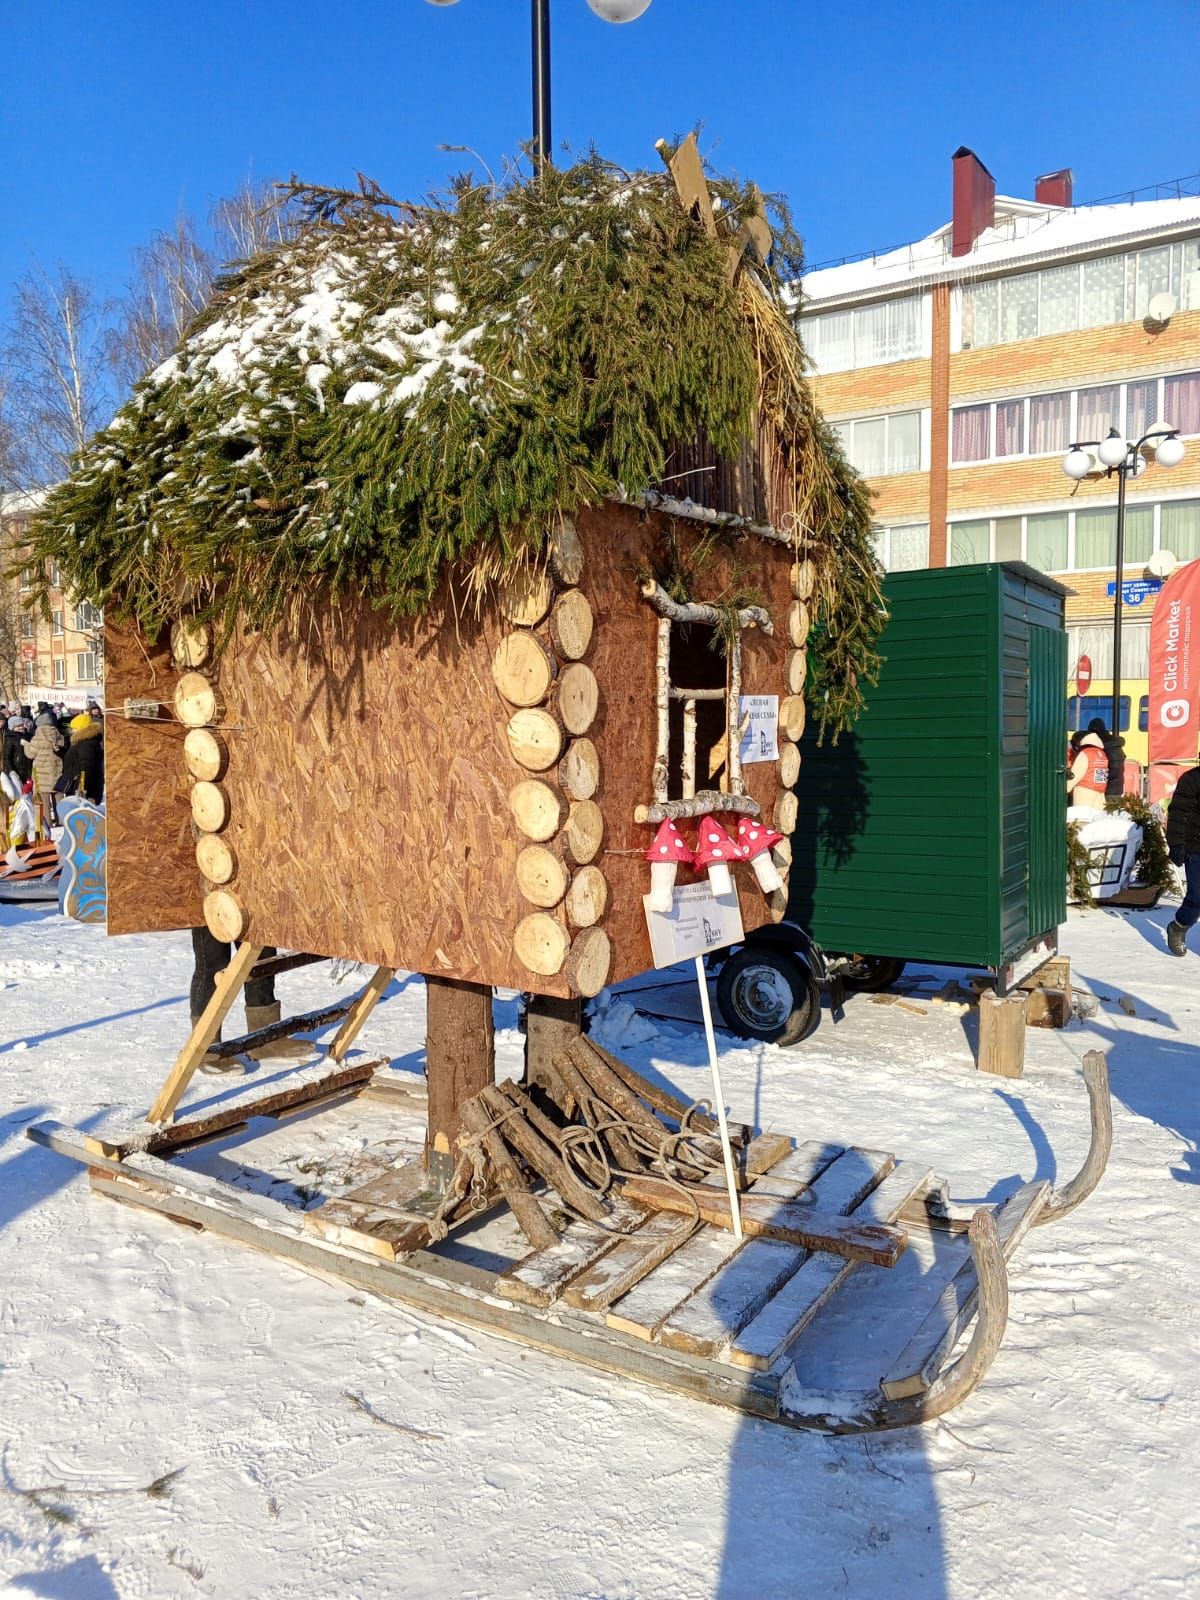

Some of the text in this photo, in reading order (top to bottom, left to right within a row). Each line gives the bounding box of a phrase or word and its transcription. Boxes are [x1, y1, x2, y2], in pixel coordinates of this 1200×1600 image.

[1128, 594, 1141, 602] 36
[1163, 599, 1181, 692] Click Market
